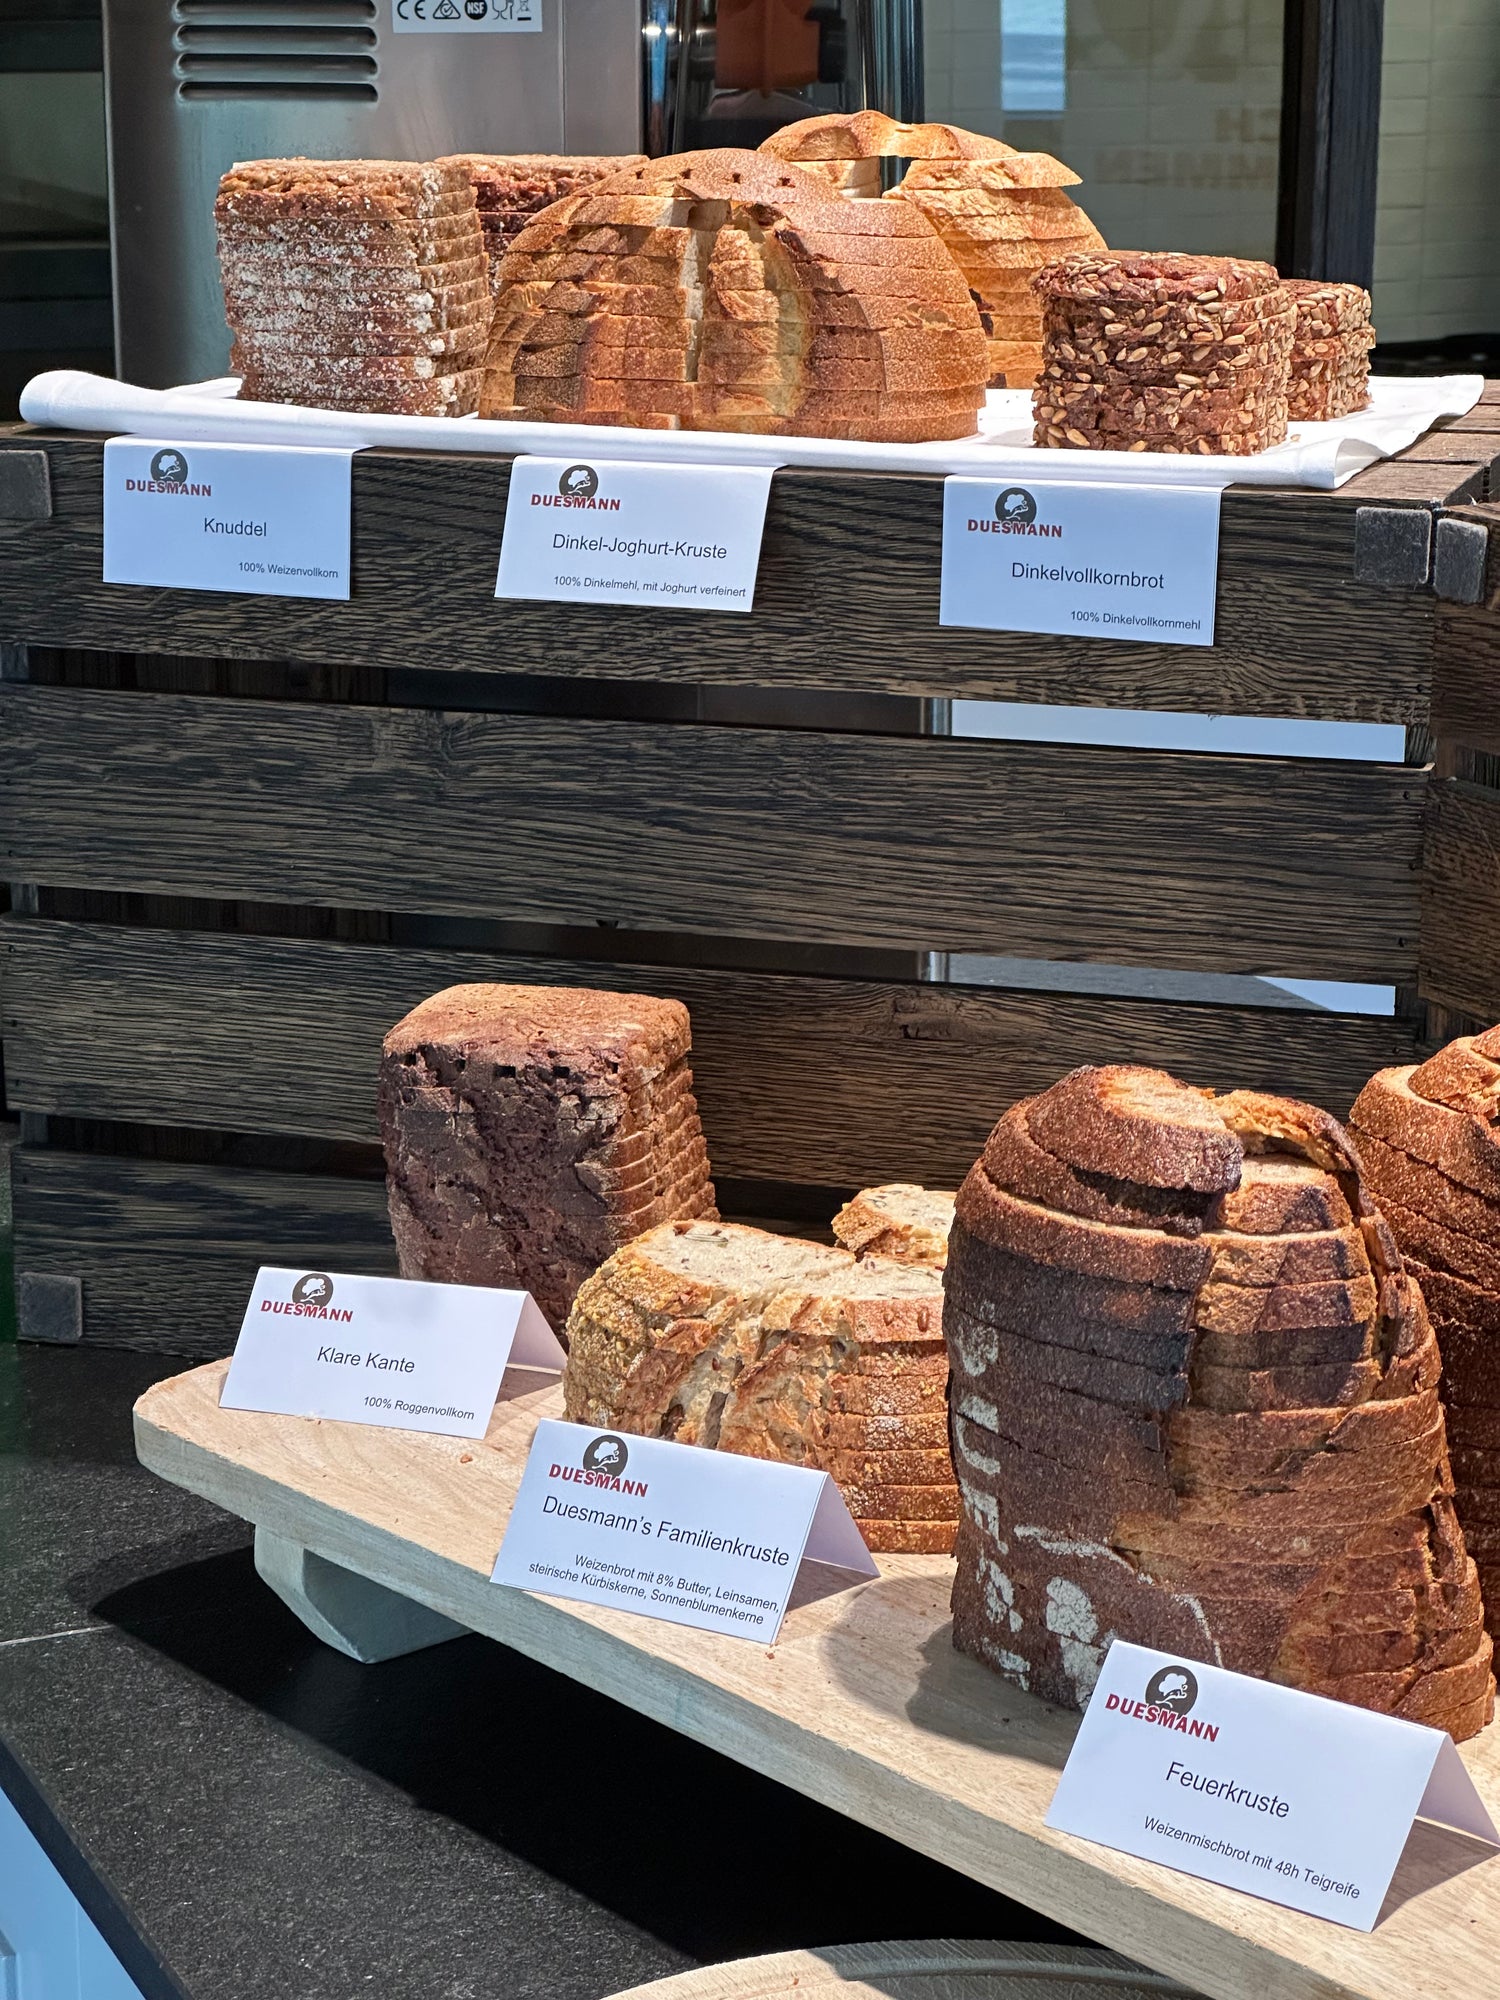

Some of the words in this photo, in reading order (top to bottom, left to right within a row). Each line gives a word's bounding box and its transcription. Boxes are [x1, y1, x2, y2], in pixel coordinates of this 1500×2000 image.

[466, 2, 484, 14] NSF
[125, 479, 211, 497] DUESMANN
[530, 494, 621, 511] DUESMANN
[204, 517, 267, 537] Knuddel
[967, 519, 1062, 538] DUESMANN
[552, 533, 727, 559] Dinkel-Joghurt-Kruste
[238, 562, 265, 574] 100%
[267, 564, 339, 578] Weizenvollkorn
[1011, 562, 1164, 589] Dinkelvollkornbrot
[553, 576, 581, 587] 100%
[584, 577, 640, 591] Dinkelmehl,
[643, 581, 658, 592] mit
[660, 582, 697, 595] Joghurt
[699, 586, 746, 597] verfeinert
[1070, 611, 1100, 623] 100%
[1102, 613, 1201, 630] Dinkelvollkornmehl
[260, 1300, 353, 1323] DUESMANN
[317, 1346, 361, 1367] Klare
[365, 1353, 416, 1374] Kante
[363, 1396, 392, 1409] 100%
[394, 1399, 475, 1420] Roggenvollkorn
[548, 1463, 649, 1498] DUESMANN
[656, 1520, 790, 1566] Familienkruste
[528, 1561, 578, 1582] steirische
[580, 1573, 648, 1600] Kürbiskerne,
[650, 1590, 764, 1626] Sonnenblumenkerne
[574, 1553, 636, 1581] Weizenbrot
[636, 1569, 654, 1583] mit
[656, 1573, 674, 1588] 8%
[676, 1578, 712, 1598] Butter,
[715, 1586, 780, 1614] Leinsamen,
[1105, 1693, 1220, 1742] DUESMANN
[1165, 1761, 1290, 1818] Feuerkruste
[1144, 1815, 1251, 1862] Weizenmischbrot
[1251, 1851, 1273, 1870] mit
[1274, 1859, 1300, 1879] 48h
[1303, 1868, 1361, 1899] Teigreife
